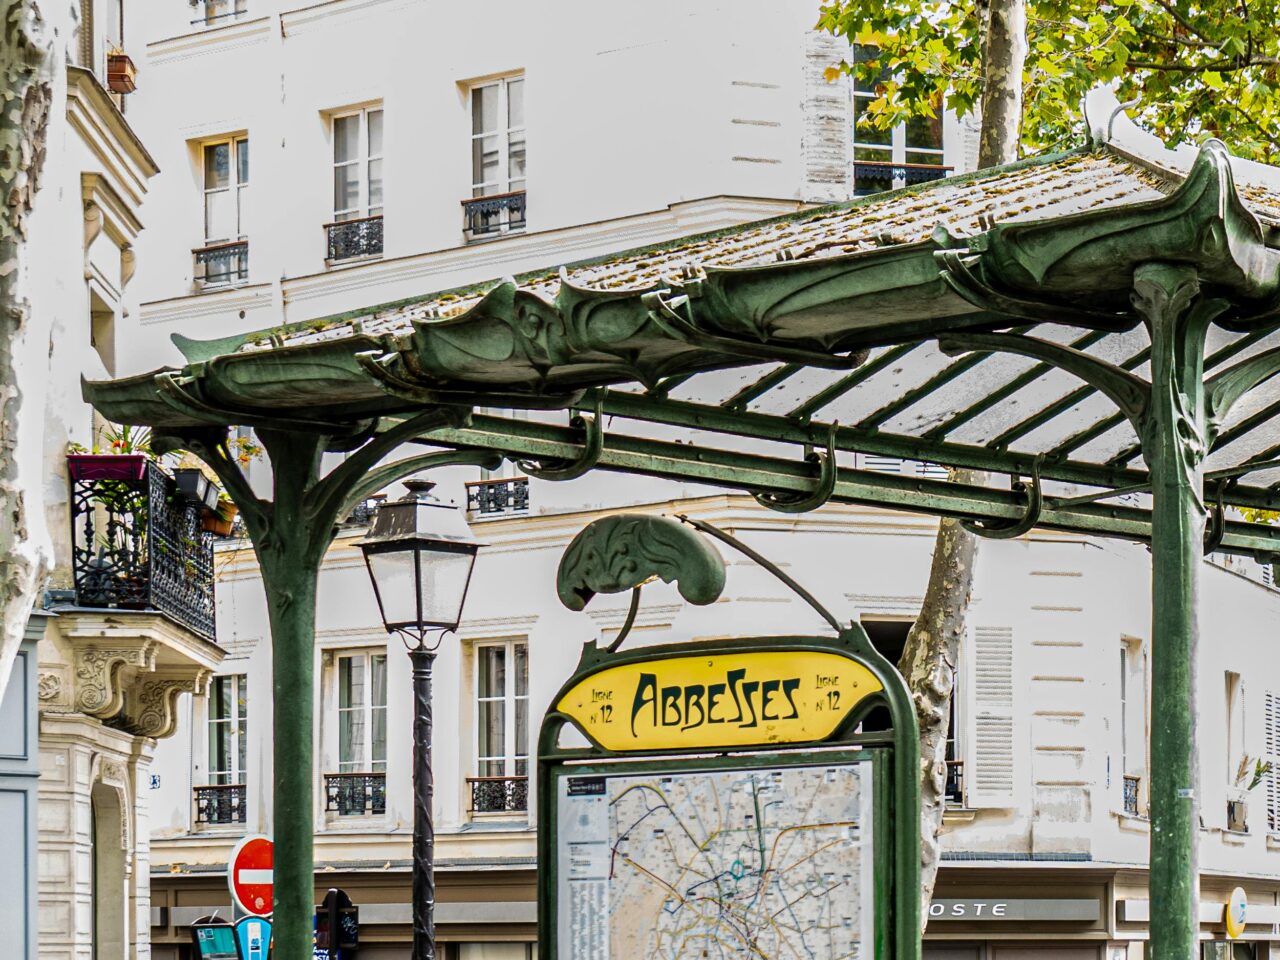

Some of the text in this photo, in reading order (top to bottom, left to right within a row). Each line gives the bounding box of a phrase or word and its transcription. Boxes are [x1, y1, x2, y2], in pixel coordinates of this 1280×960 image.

[630, 668, 801, 738] ABBESSES
[826, 690, 841, 711] 12
[600, 704, 613, 724] 12
[929, 903, 1008, 916] OSTE
